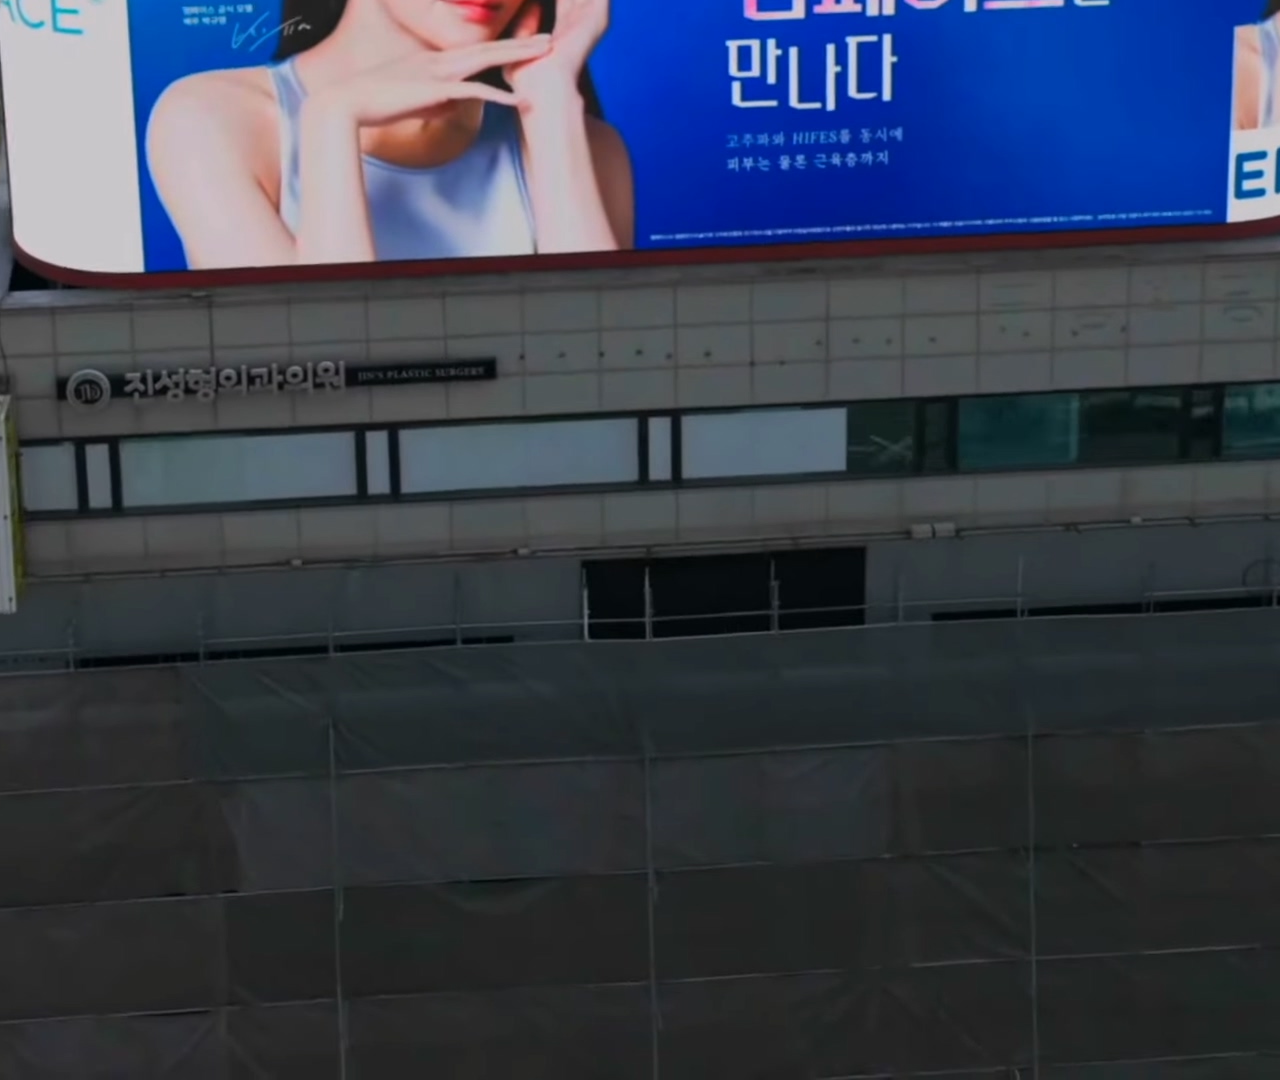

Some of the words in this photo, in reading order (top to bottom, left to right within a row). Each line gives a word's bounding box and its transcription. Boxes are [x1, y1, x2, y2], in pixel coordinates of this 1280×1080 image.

[725, 33, 898, 111] 만나다
[726, 131, 785, 148] 고주파와
[859, 126, 903, 144] 동시에
[726, 156, 771, 172] 피부는
[778, 154, 807, 170] 물론
[813, 150, 889, 168] 근육층까지
[123, 360, 346, 403] 진성형외과의원
[386, 368, 432, 379] PLASTIC
[435, 366, 485, 377] SURGERY
